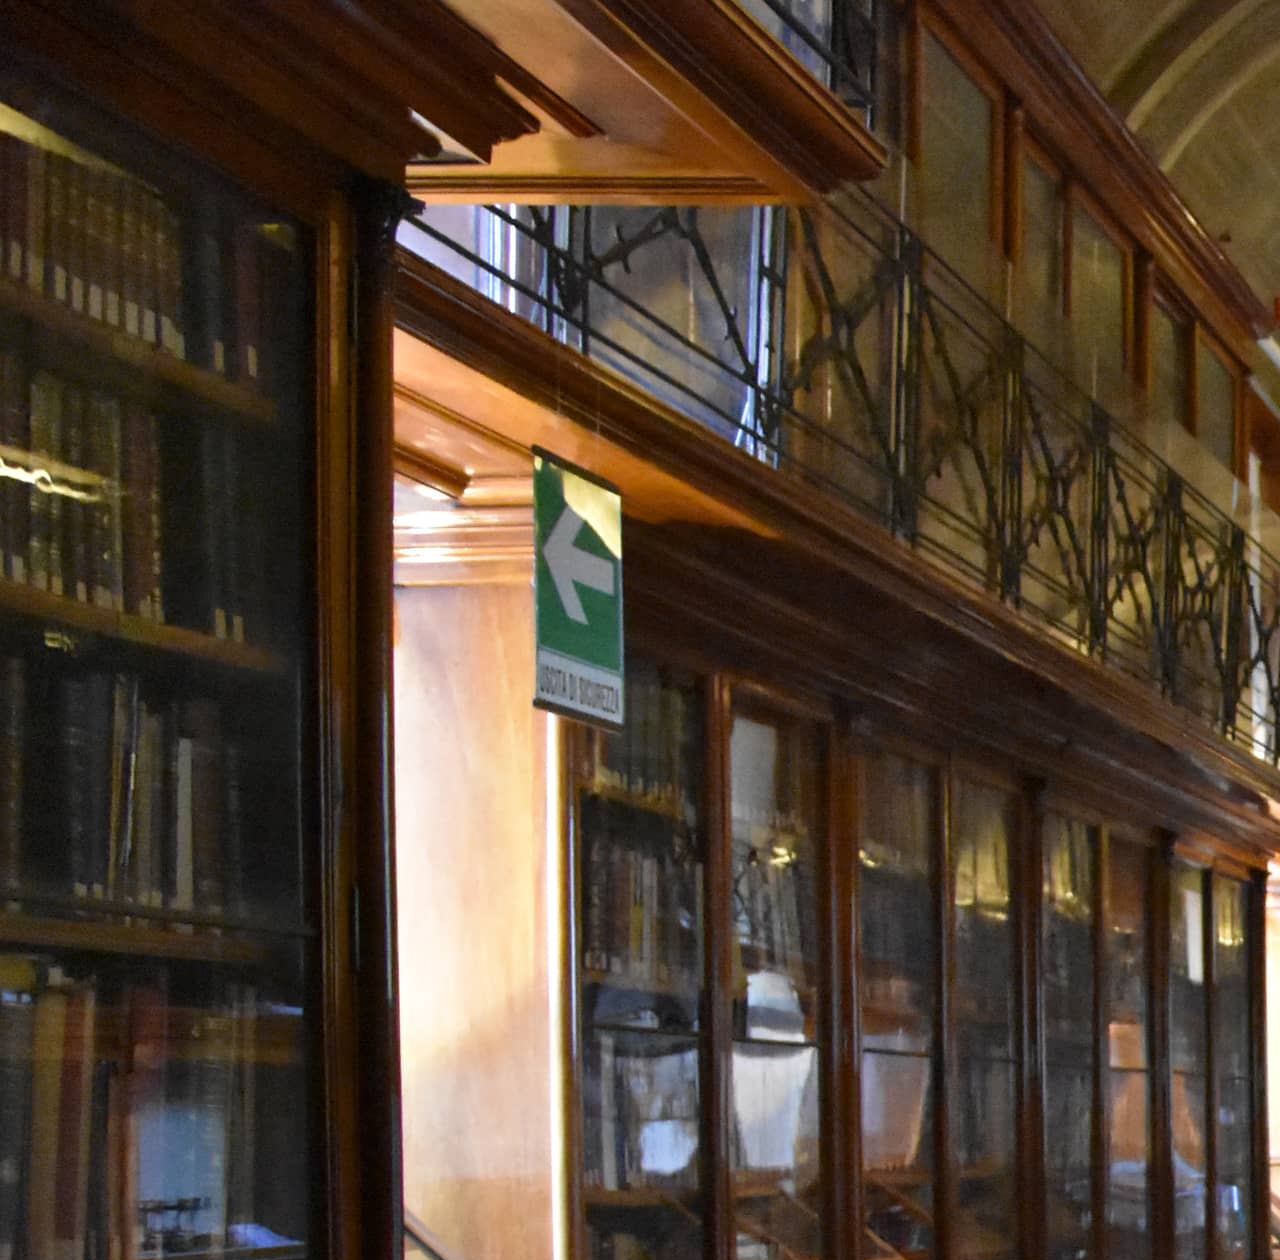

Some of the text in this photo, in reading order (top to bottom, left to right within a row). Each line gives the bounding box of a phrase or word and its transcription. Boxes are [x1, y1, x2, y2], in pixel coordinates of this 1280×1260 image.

[540, 664, 619, 713] USCITA DI SICUREZZA
